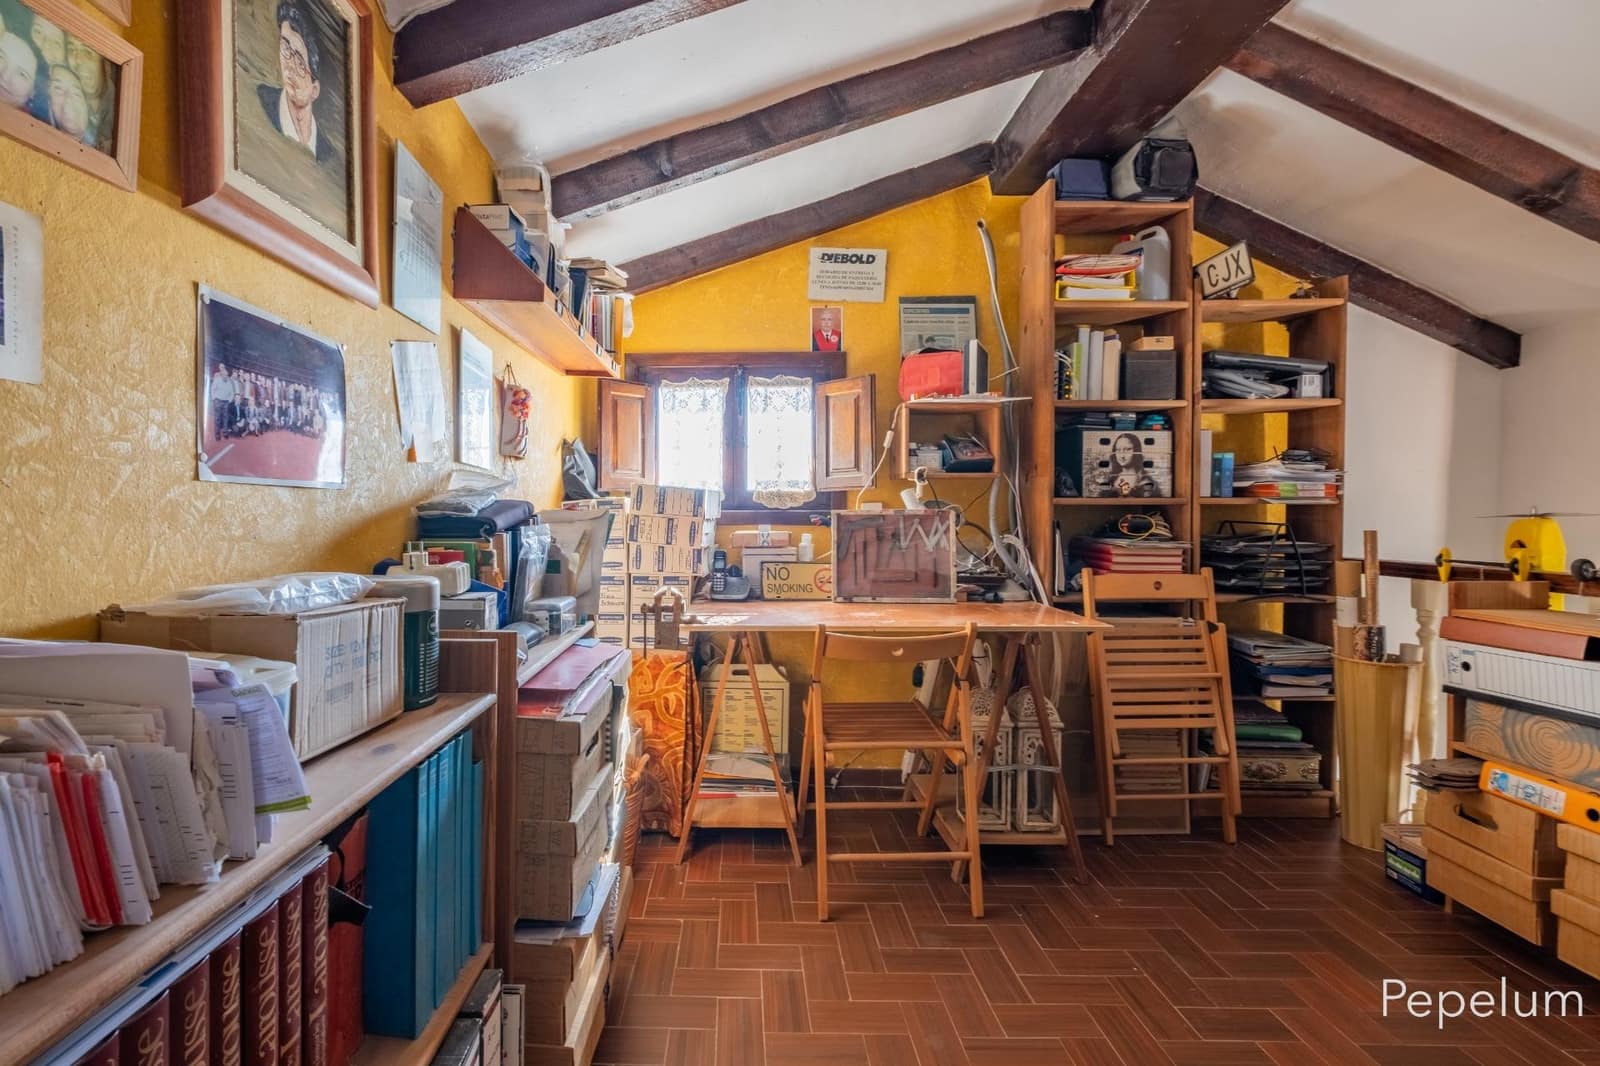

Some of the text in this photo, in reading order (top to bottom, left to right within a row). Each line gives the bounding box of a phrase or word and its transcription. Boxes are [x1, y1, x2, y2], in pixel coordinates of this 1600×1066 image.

[818, 252, 876, 264] DIEBOLD
[766, 567, 790, 581] NO
[767, 583, 813, 593] SMOKING
[309, 871, 328, 1028] Larousse
[280, 894, 302, 1057] Larousse
